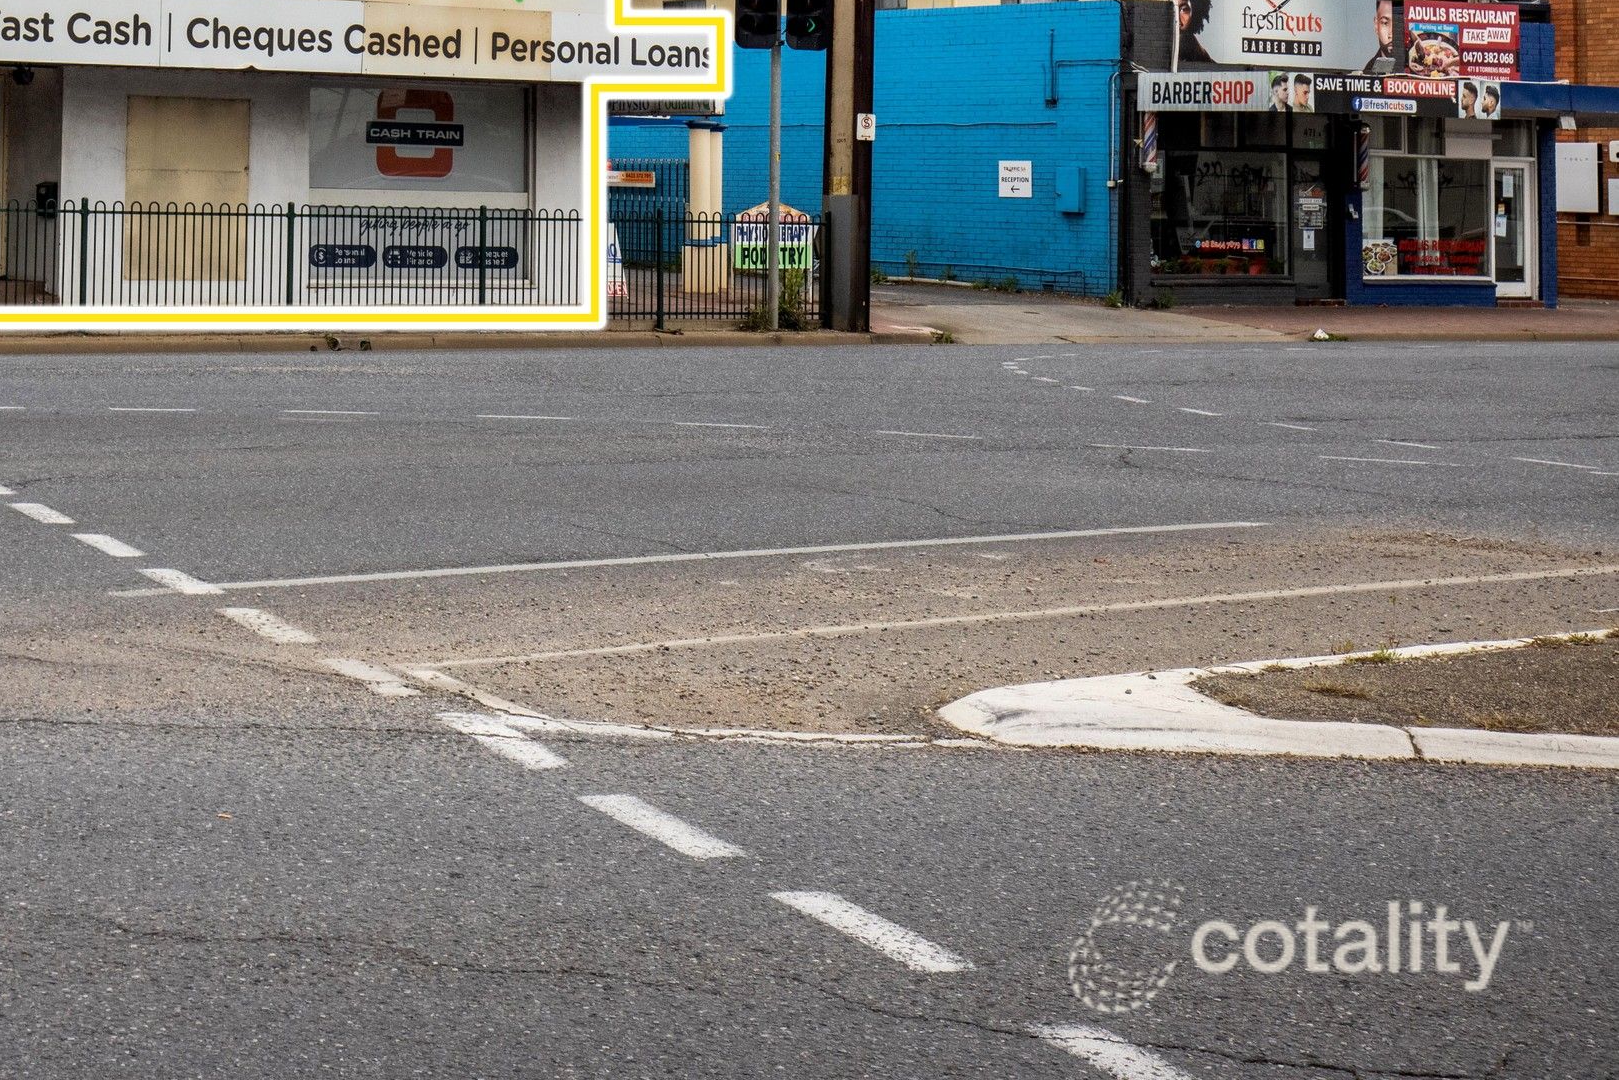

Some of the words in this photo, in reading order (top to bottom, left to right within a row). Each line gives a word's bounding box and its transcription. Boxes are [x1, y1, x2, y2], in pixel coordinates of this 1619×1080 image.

[1408, 6, 1447, 21] ADULIS
[1449, 8, 1517, 25] RESTAURANT
[67, 12, 152, 47] Cash
[186, 17, 332, 57] Cheques
[344, 24, 462, 59] Cashed
[491, 31, 620, 65] Personal
[630, 37, 710, 69] Loans
[1466, 30, 1485, 41] TAKE
[1486, 29, 1509, 40] AWAY
[1243, 39, 1286, 53] BARBER
[1293, 42, 1321, 55] SHOP
[1462, 52, 1482, 63] 0470
[1483, 52, 1498, 63] 382
[1499, 53, 1514, 64] 068
[1151, 80, 1254, 104] BARBERSHOP
[1316, 78, 1343, 91] SAVE
[1344, 79, 1371, 92] TIME
[1373, 80, 1382, 93] &
[1387, 80, 1417, 94] BOOK
[1418, 82, 1456, 96] ONLINE
[1364, 99, 1414, 111] @freshcutssa
[370, 128, 411, 138] CASH
[416, 130, 460, 140] TRAIN
[736, 225, 810, 242] PHYSIOERAPY
[335, 256, 356, 264] oans
[742, 247, 805, 265] PODTRY
